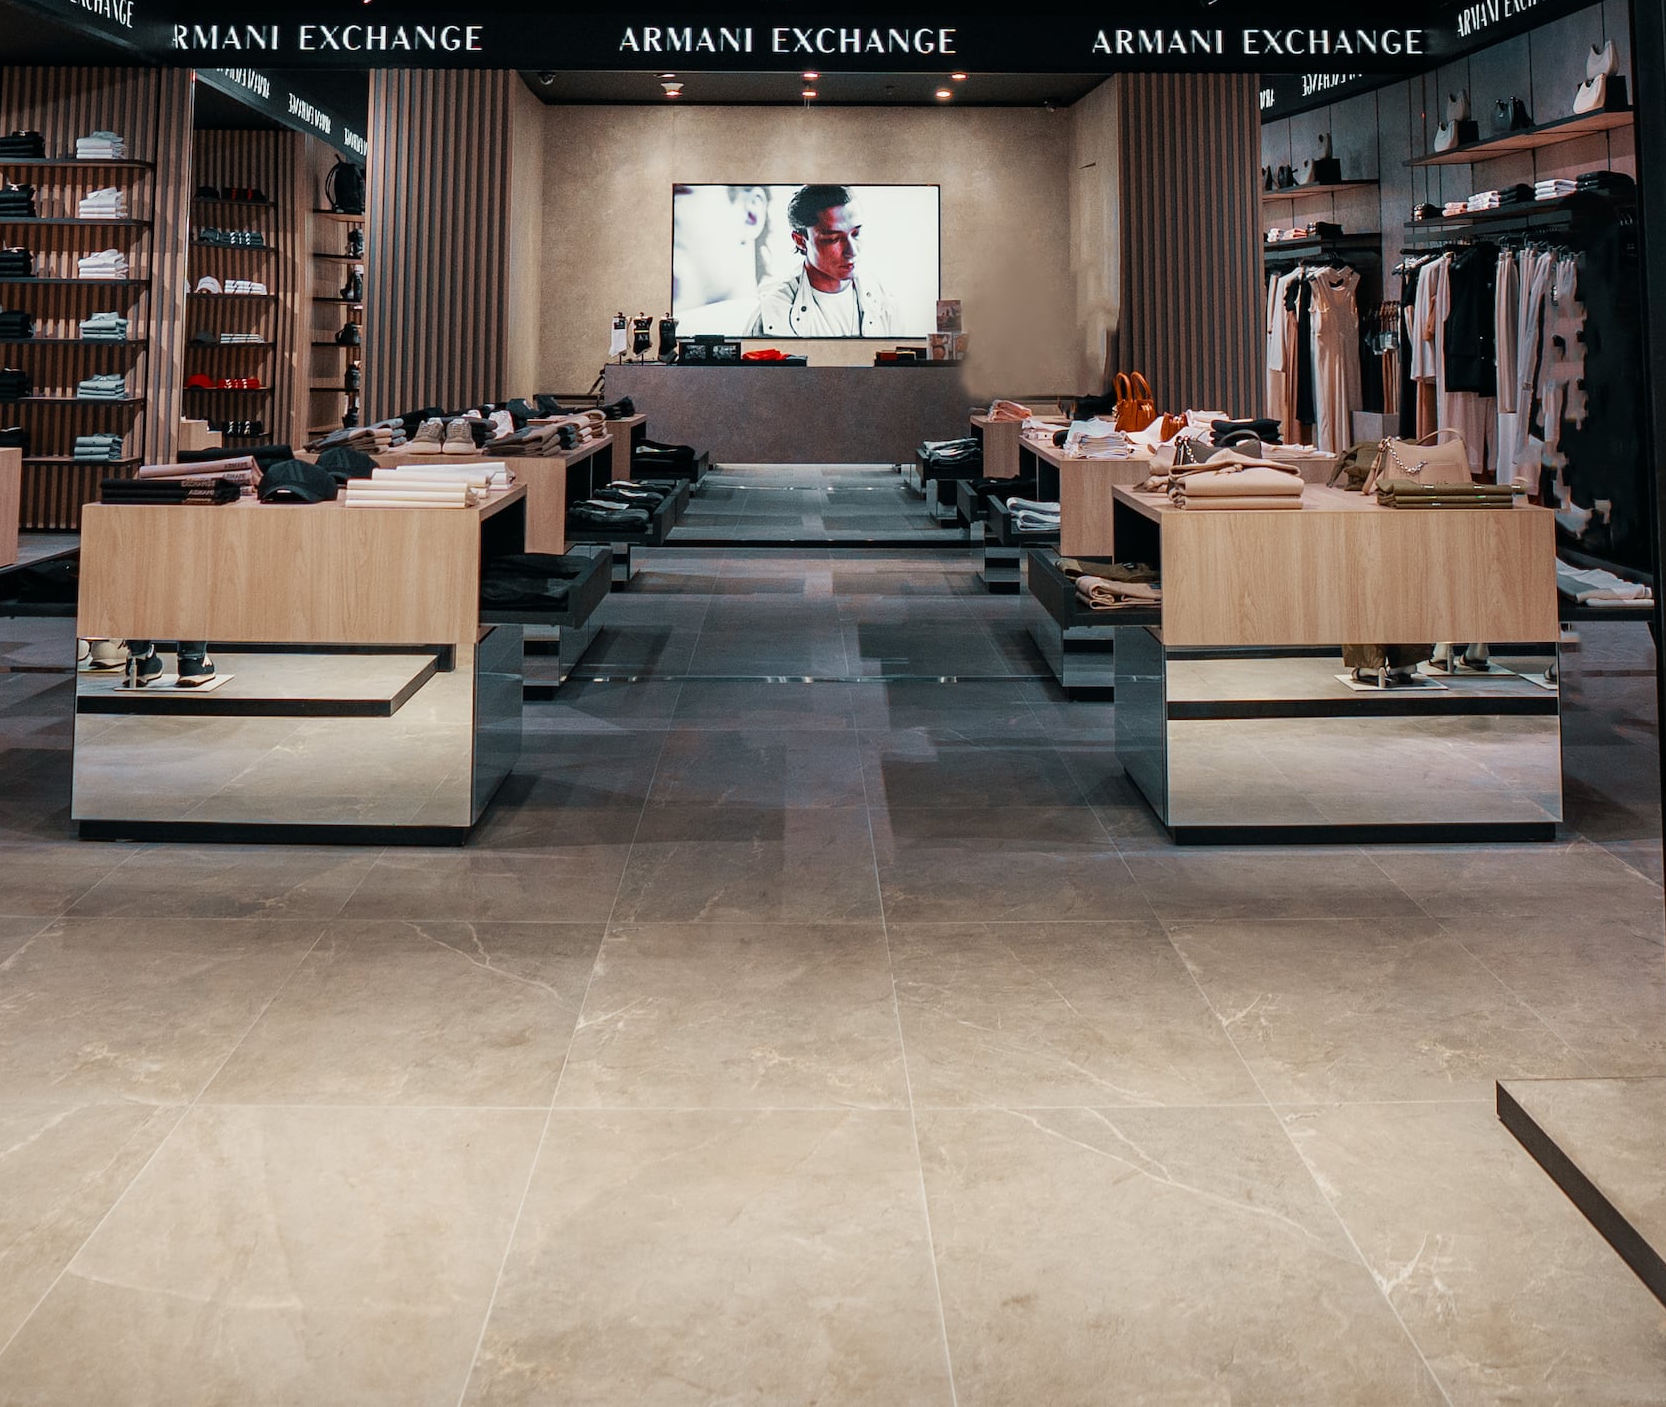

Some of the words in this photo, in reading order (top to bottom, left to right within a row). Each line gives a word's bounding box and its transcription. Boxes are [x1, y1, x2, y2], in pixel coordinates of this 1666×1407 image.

[173, 24, 279, 50] RMANI
[300, 25, 483, 51] EXCHANGE
[619, 27, 752, 52] ARMANI
[772, 28, 956, 54] EXCHANGE
[1092, 30, 1222, 54] ARMANI
[1243, 29, 1423, 54] EXCHANGE
